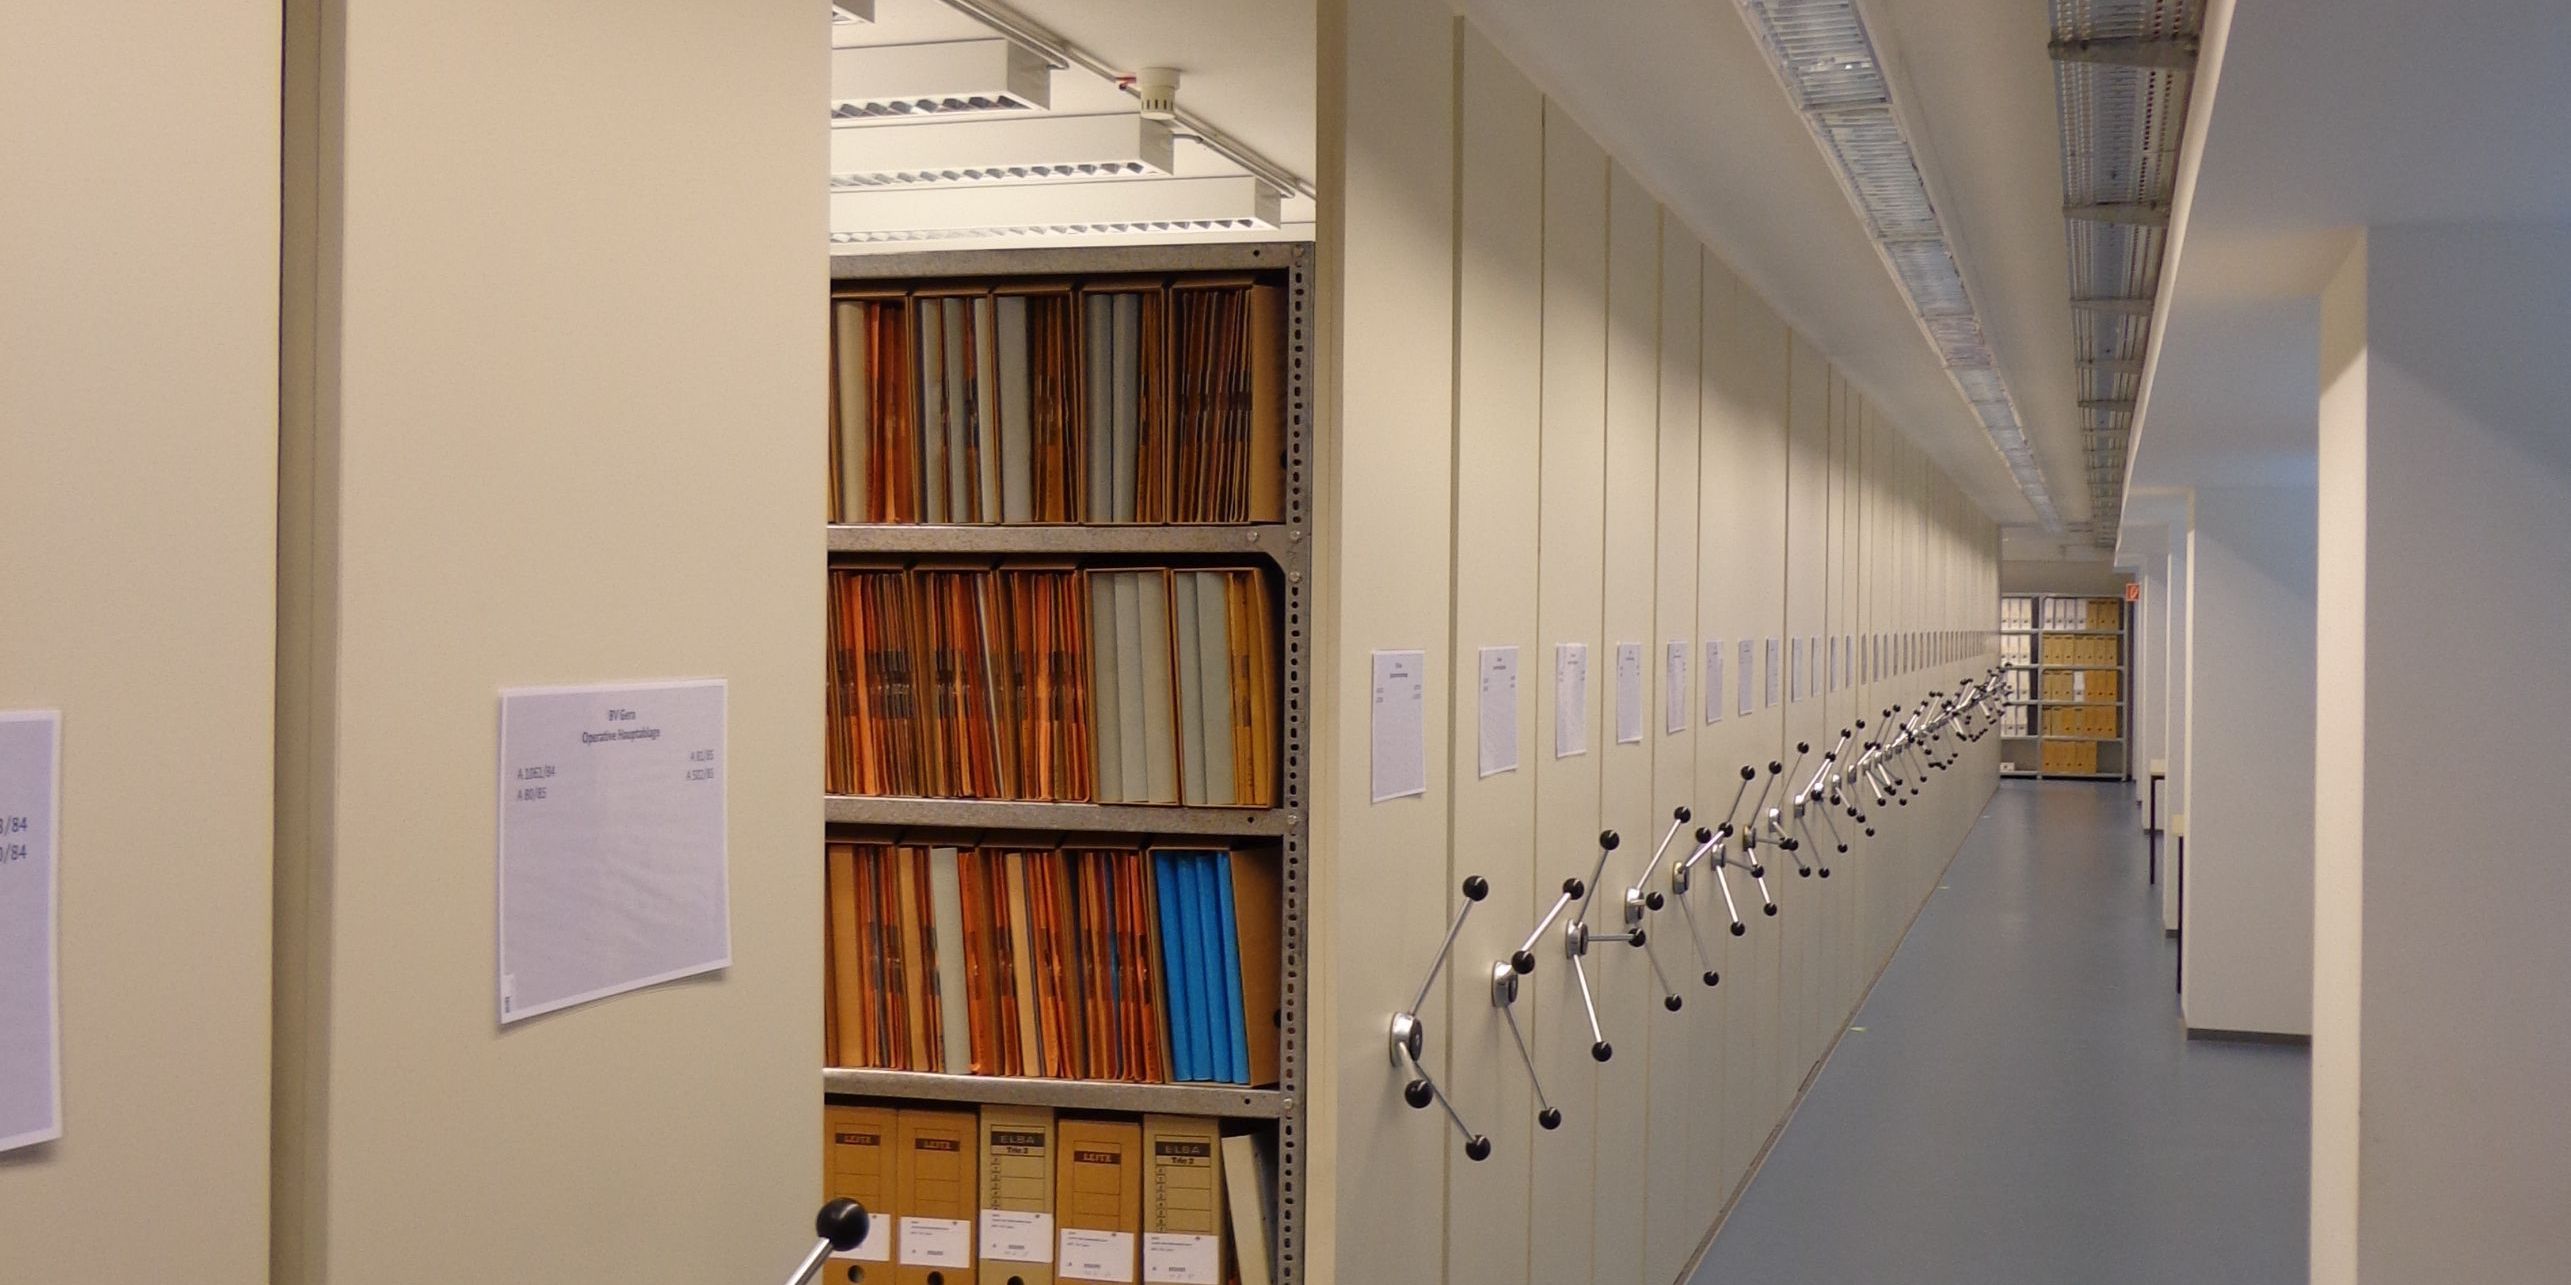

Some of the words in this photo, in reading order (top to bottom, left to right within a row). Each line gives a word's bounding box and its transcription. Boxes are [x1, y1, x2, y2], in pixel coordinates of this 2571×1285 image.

[999, 1134, 1035, 1145] ELBA
[1164, 1144, 1201, 1154] ELBA
[1083, 1152, 1112, 1163] LEITZ
